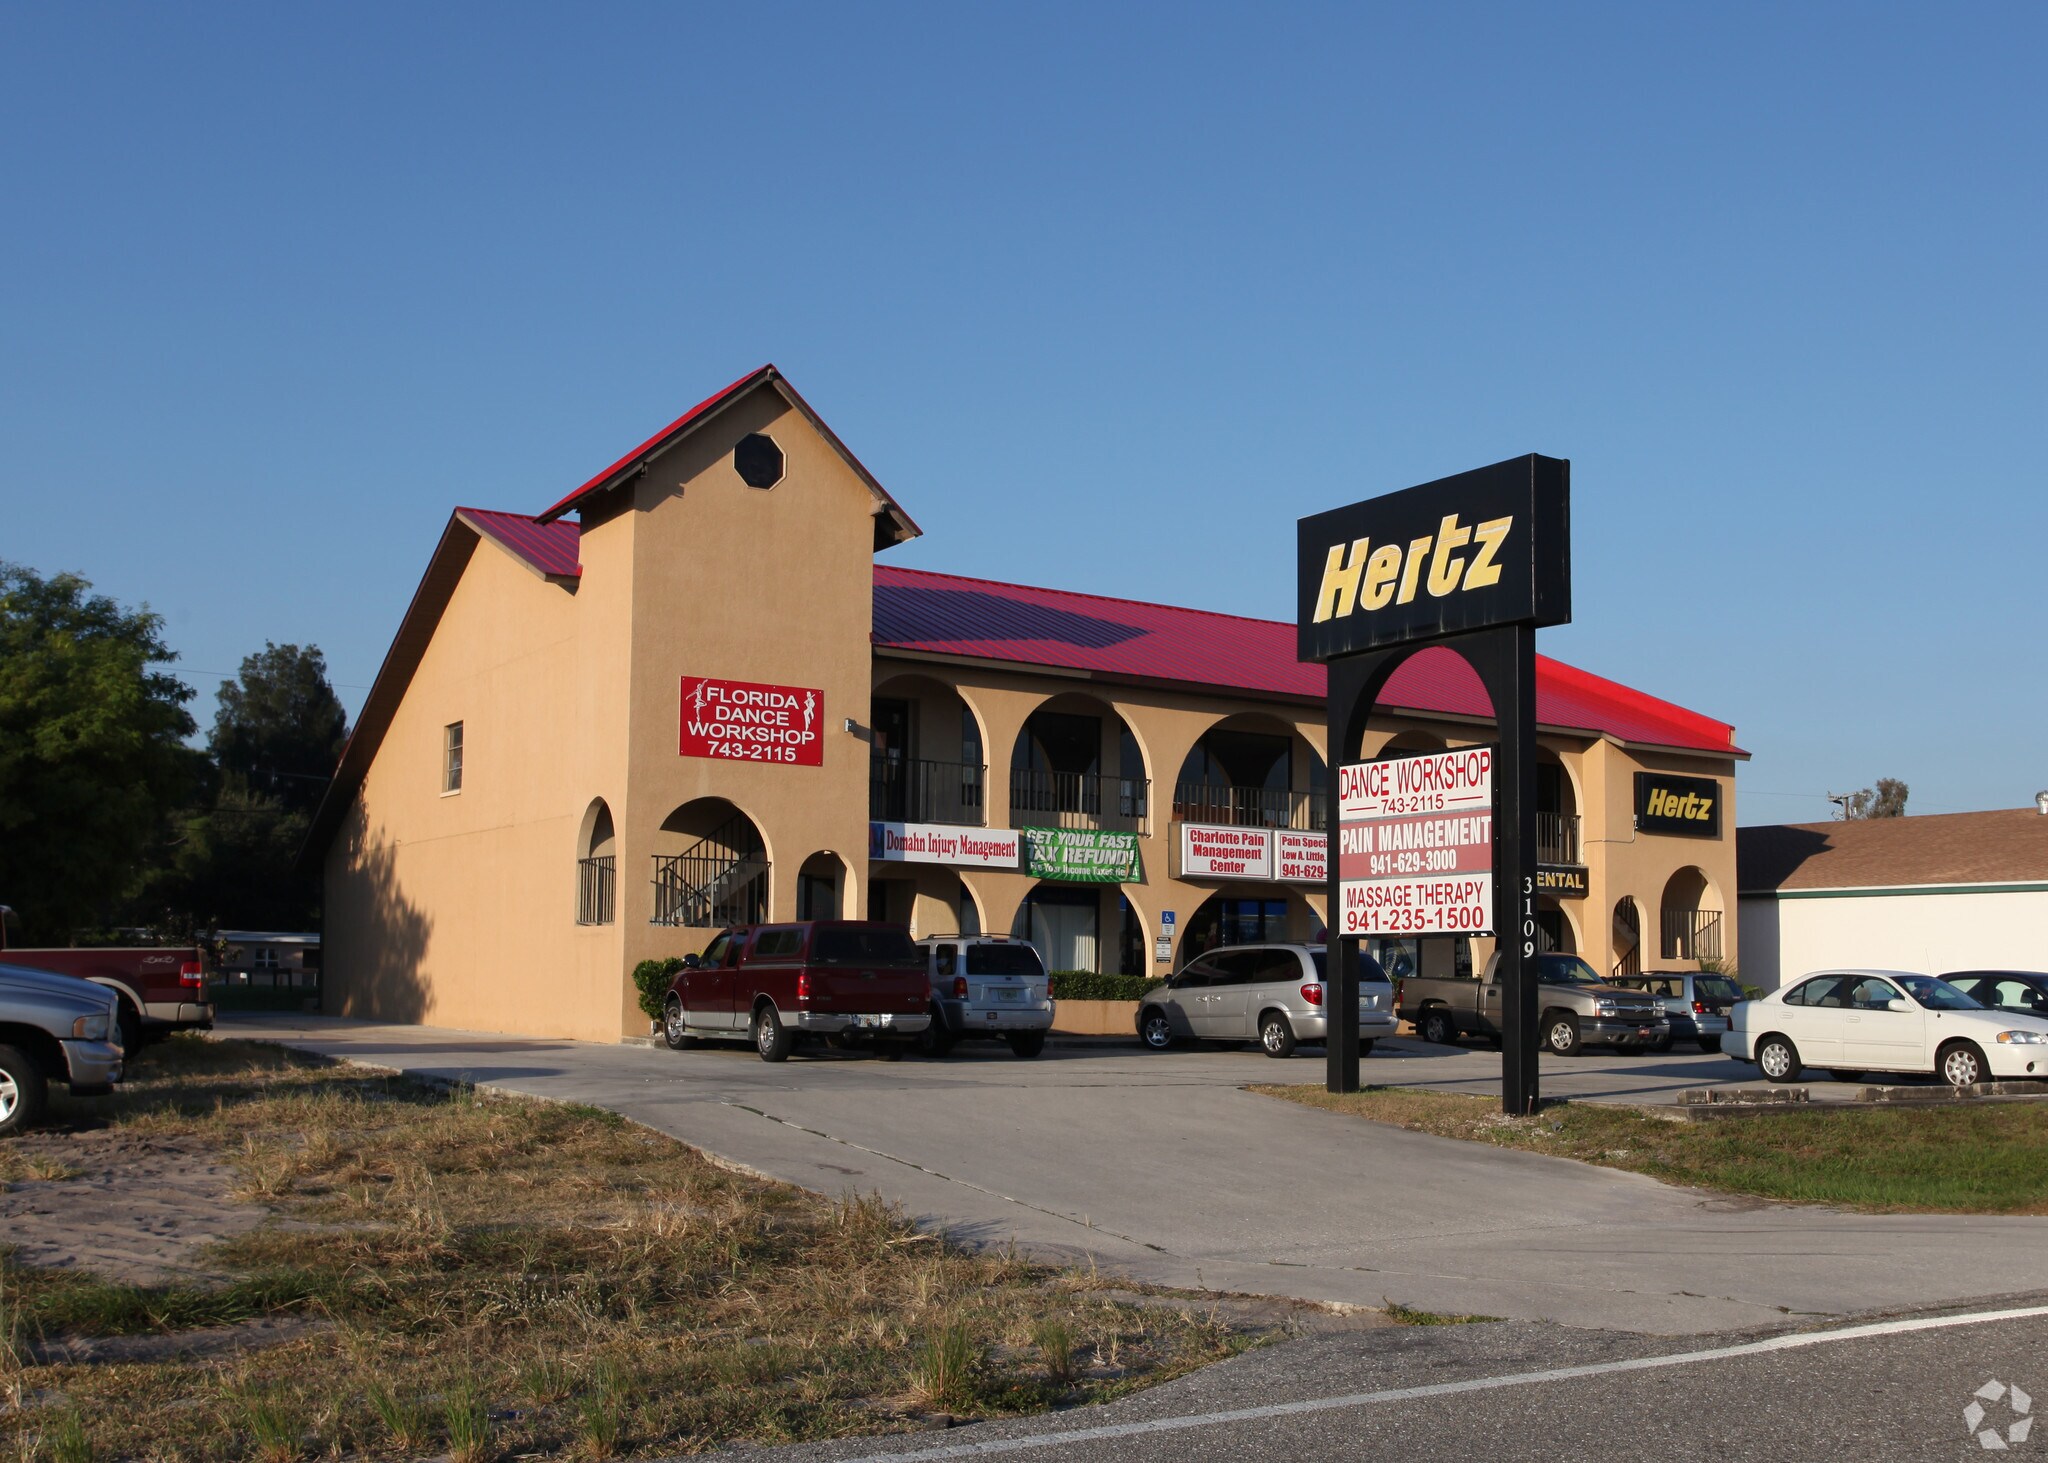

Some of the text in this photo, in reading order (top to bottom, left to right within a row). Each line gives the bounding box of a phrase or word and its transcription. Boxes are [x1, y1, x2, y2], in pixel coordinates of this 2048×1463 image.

[1312, 513, 1513, 624] Hertz
[706, 686, 800, 710] FLORIDA
[715, 705, 790, 726] DANCE
[687, 720, 815, 745] WORKSHOP
[707, 740, 797, 762] 743-2115
[1340, 751, 1491, 800] DANCE WORKSHOP
[1381, 793, 1444, 814] 743-2115
[1646, 788, 1713, 821] Hertz
[886, 829, 1016, 861] Domahn Injury Management
[1026, 829, 1135, 849] GET YOUR FAST
[1189, 829, 1265, 847] Charlotte Pain
[1281, 836, 1327, 848] Pain Speci
[1340, 815, 1491, 855] PAIN MANAGEMENT
[1027, 843, 1135, 865] TAX REFUND!
[1192, 844, 1262, 860] Management
[1282, 850, 1297, 860] Lew
[1370, 849, 1457, 875] 941-629-3000
[1210, 859, 1246, 873] Center
[1282, 863, 1327, 878] 941-629-
[1536, 871, 1585, 889] ENTAL
[1346, 881, 1484, 909] MASSAGE THERAPY
[1346, 905, 1484, 932] 941-235-1500
[1523, 876, 1535, 958] 3109
